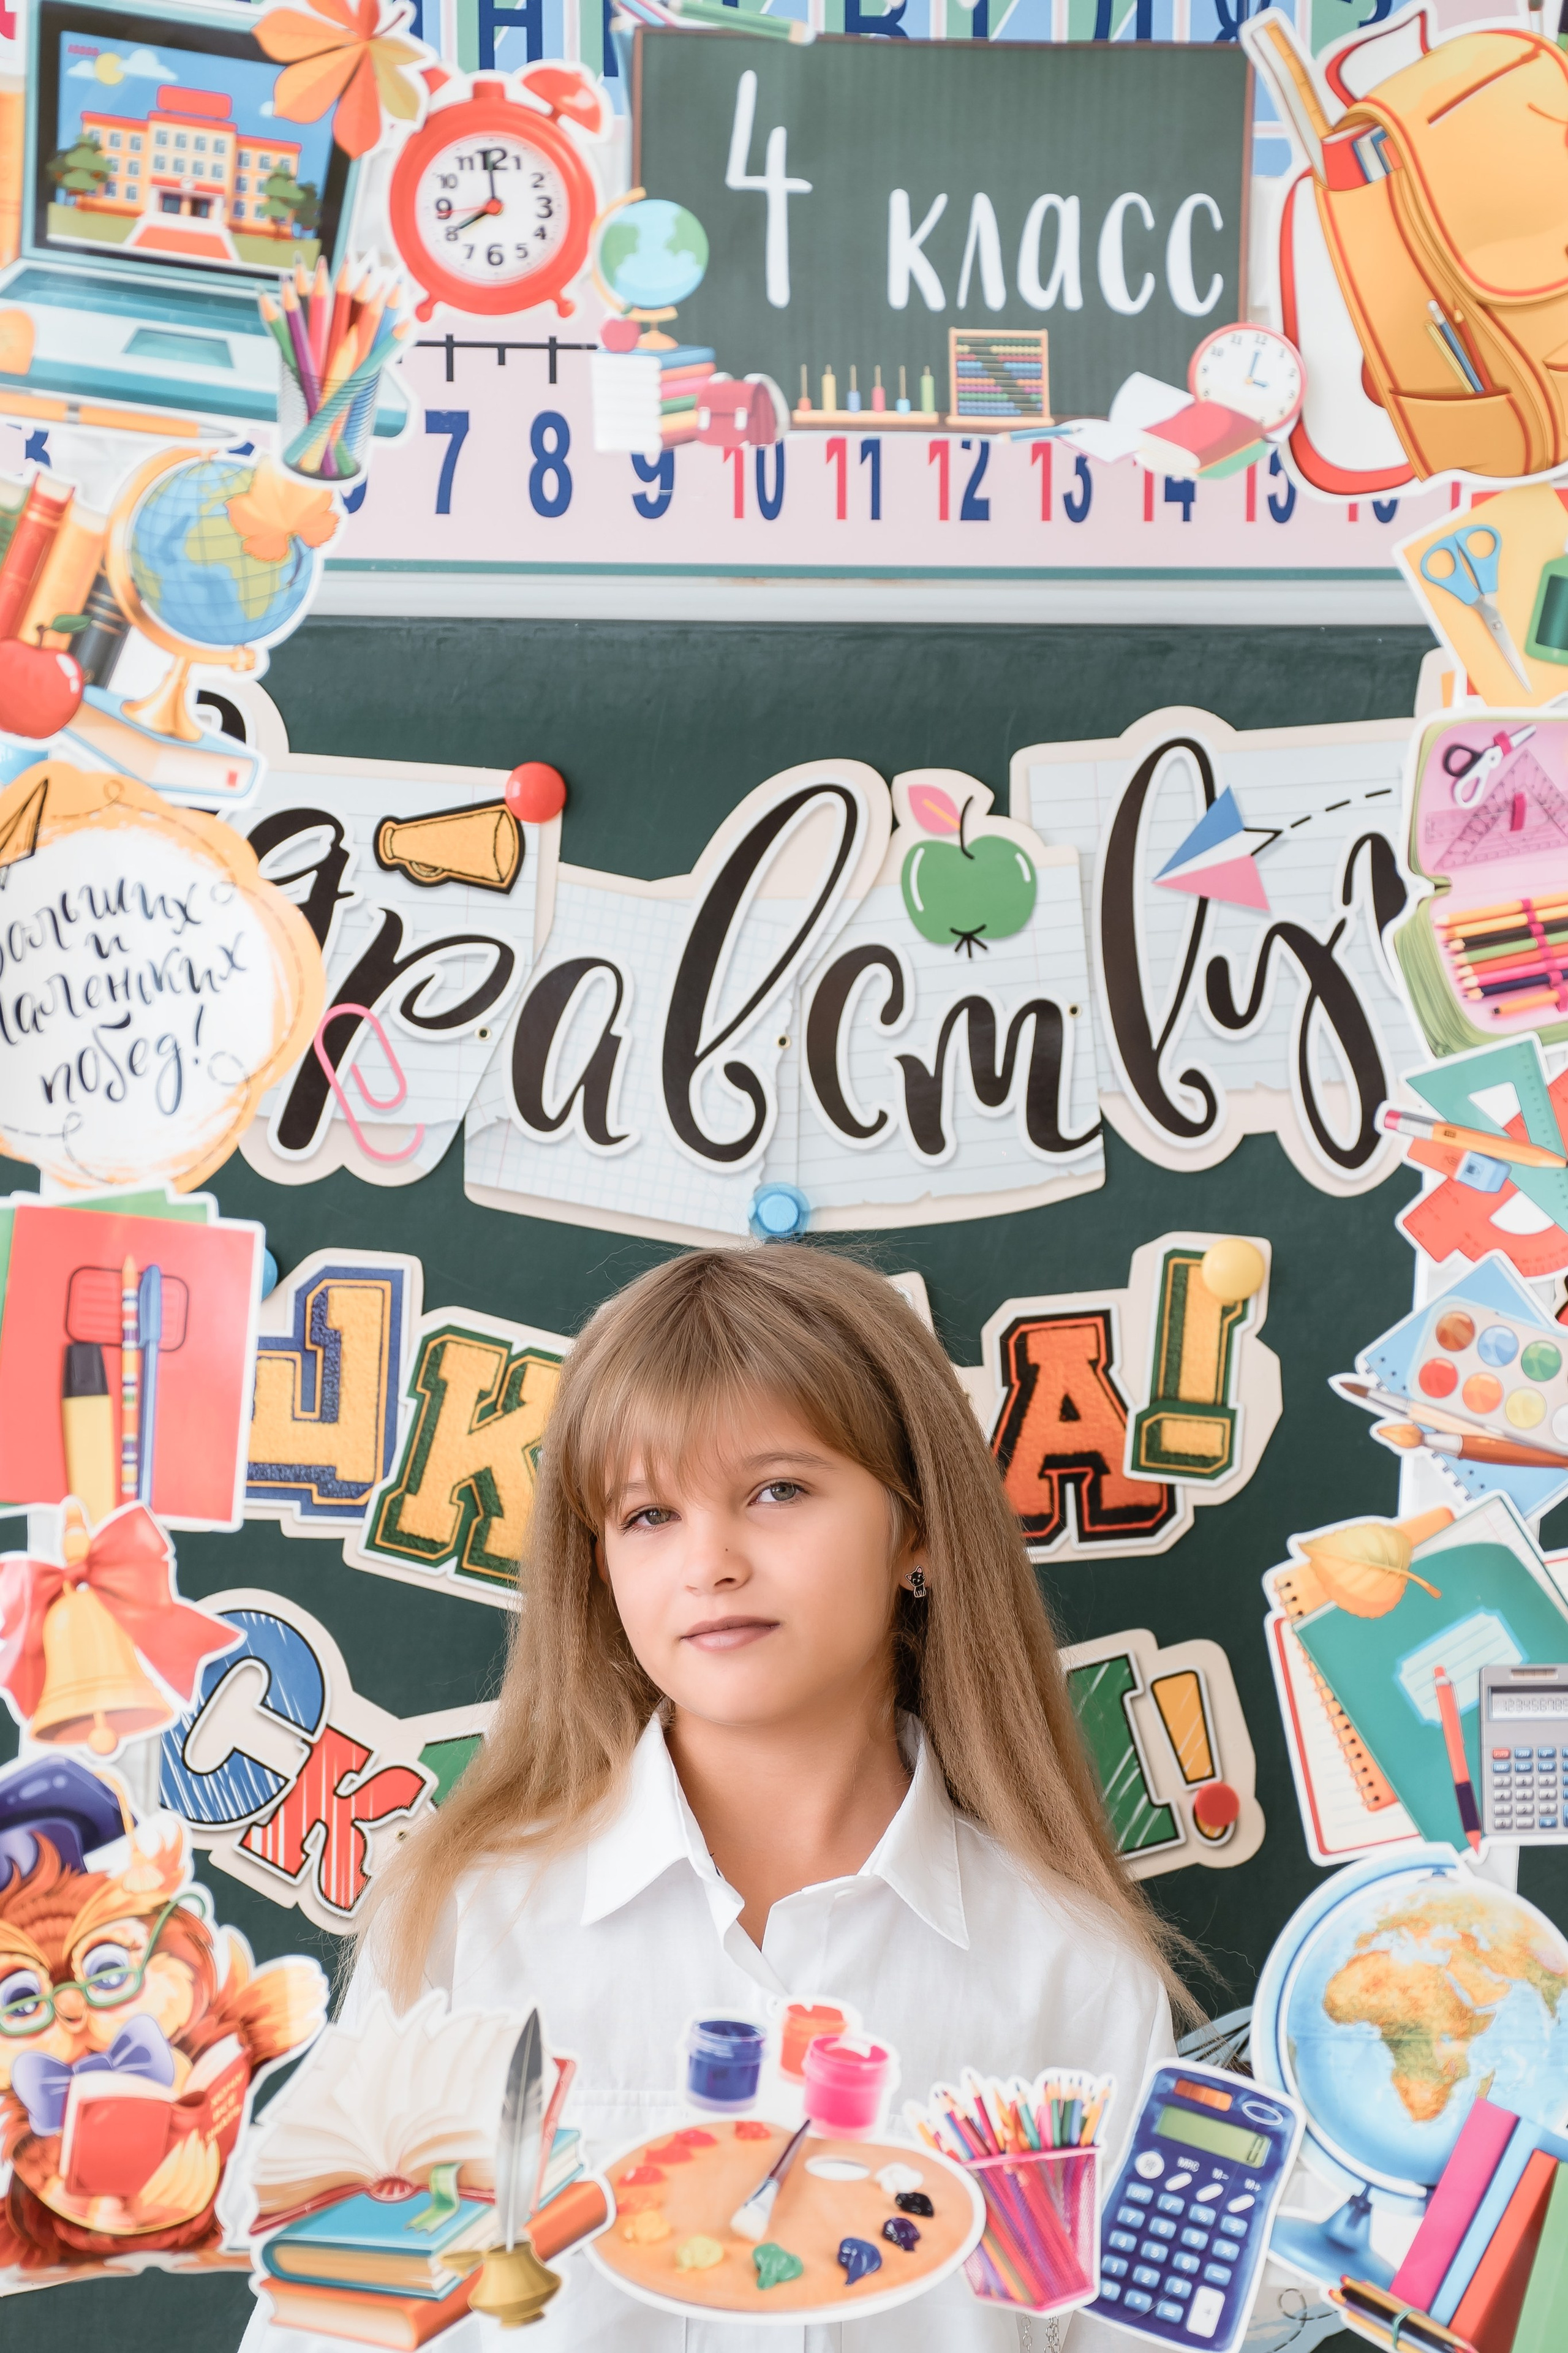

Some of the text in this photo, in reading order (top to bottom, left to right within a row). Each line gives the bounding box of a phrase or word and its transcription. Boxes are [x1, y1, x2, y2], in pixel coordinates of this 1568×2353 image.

[475, 148, 508, 171] 12
[512, 154, 521, 170] 1
[436, 173, 458, 189] 10
[530, 172, 545, 188] 2
[725, 70, 1224, 317] 4 класс
[435, 197, 453, 219] 9
[536, 197, 552, 218] 3
[445, 225, 459, 241] 8
[533, 225, 546, 240] 4
[464, 244, 475, 260] 7
[487, 244, 503, 266] 6
[515, 243, 528, 259] 5
[426, 410, 469, 515] 7
[529, 410, 573, 518] 8
[631, 450, 674, 519] 9
[723, 444, 785, 521] 10
[826, 437, 881, 521] 11
[929, 439, 990, 521] 12
[1031, 441, 1093, 524] 13
[85, 932, 130, 959] и
[40, 1003, 205, 1116] побед!
